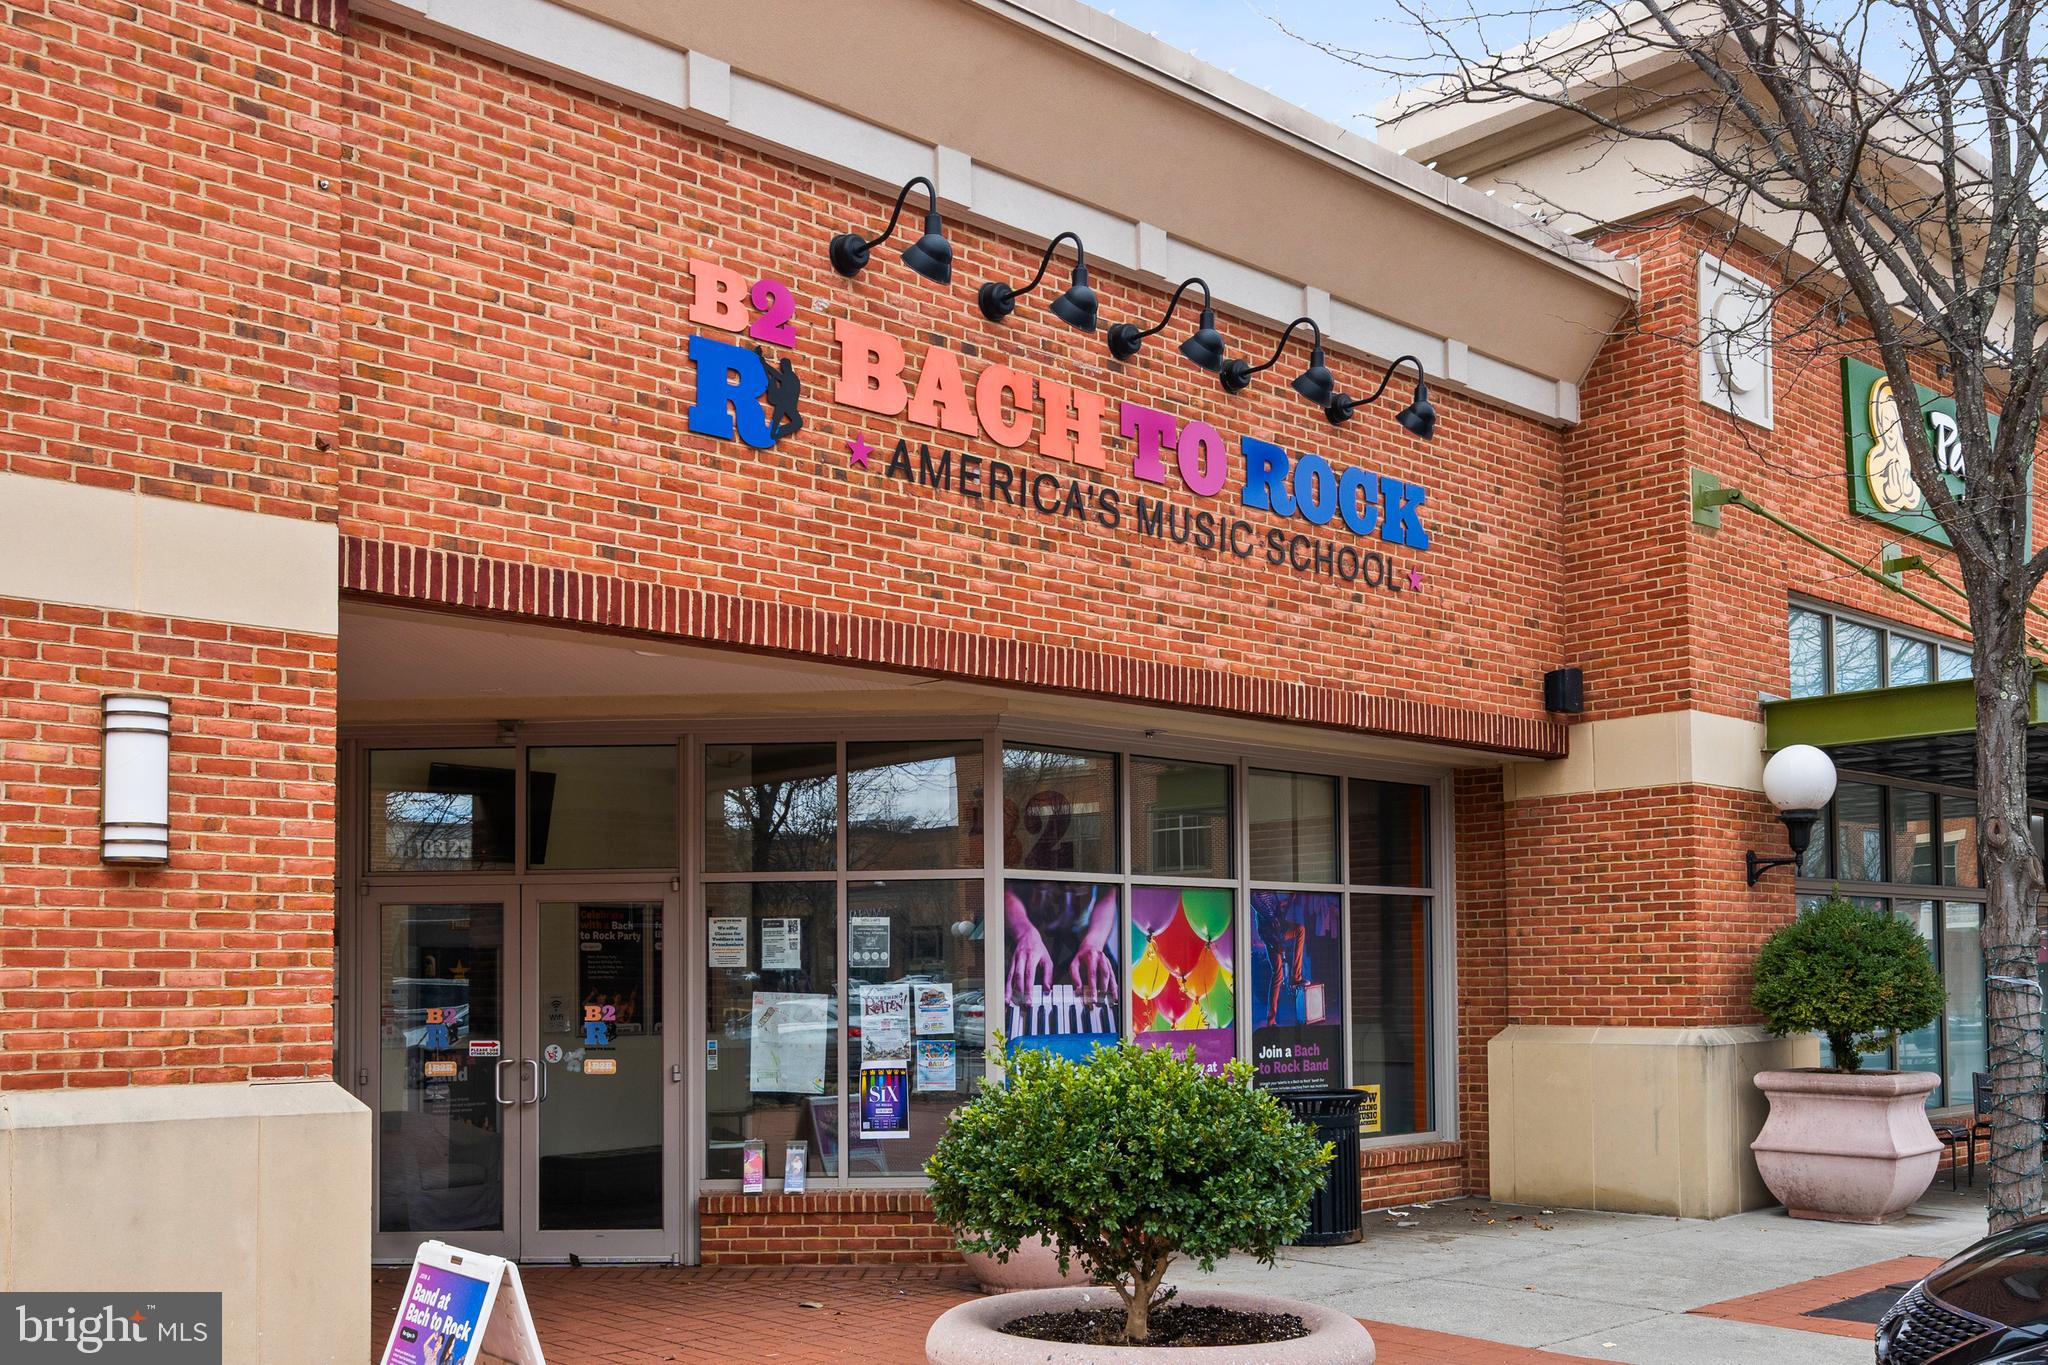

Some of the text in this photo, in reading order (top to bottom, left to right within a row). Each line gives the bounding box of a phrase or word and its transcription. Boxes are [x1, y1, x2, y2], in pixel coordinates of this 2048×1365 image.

[688, 257, 797, 348] B2
[688, 335, 779, 450] R
[834, 318, 1429, 551] BACH TO ROCK
[886, 440, 1402, 592] AMERICA'S MUSIC SCHOOL
[611, 921, 634, 930] Bach
[580, 931, 641, 943] to Rock Party
[426, 1008, 457, 1025] B2
[584, 1005, 616, 1021] B2
[426, 1024, 449, 1048] R
[584, 1022, 609, 1046] R
[1259, 1043, 1320, 1059] Join a Bach
[1206, 1061, 1218, 1073] at
[1259, 1058, 1329, 1074] to Rock Band
[1359, 1103, 1377, 1111] IRING
[1359, 1112, 1377, 1120] USIC
[412, 1282, 451, 1310] Band at
[405, 1302, 472, 1342] Bach to Rock
